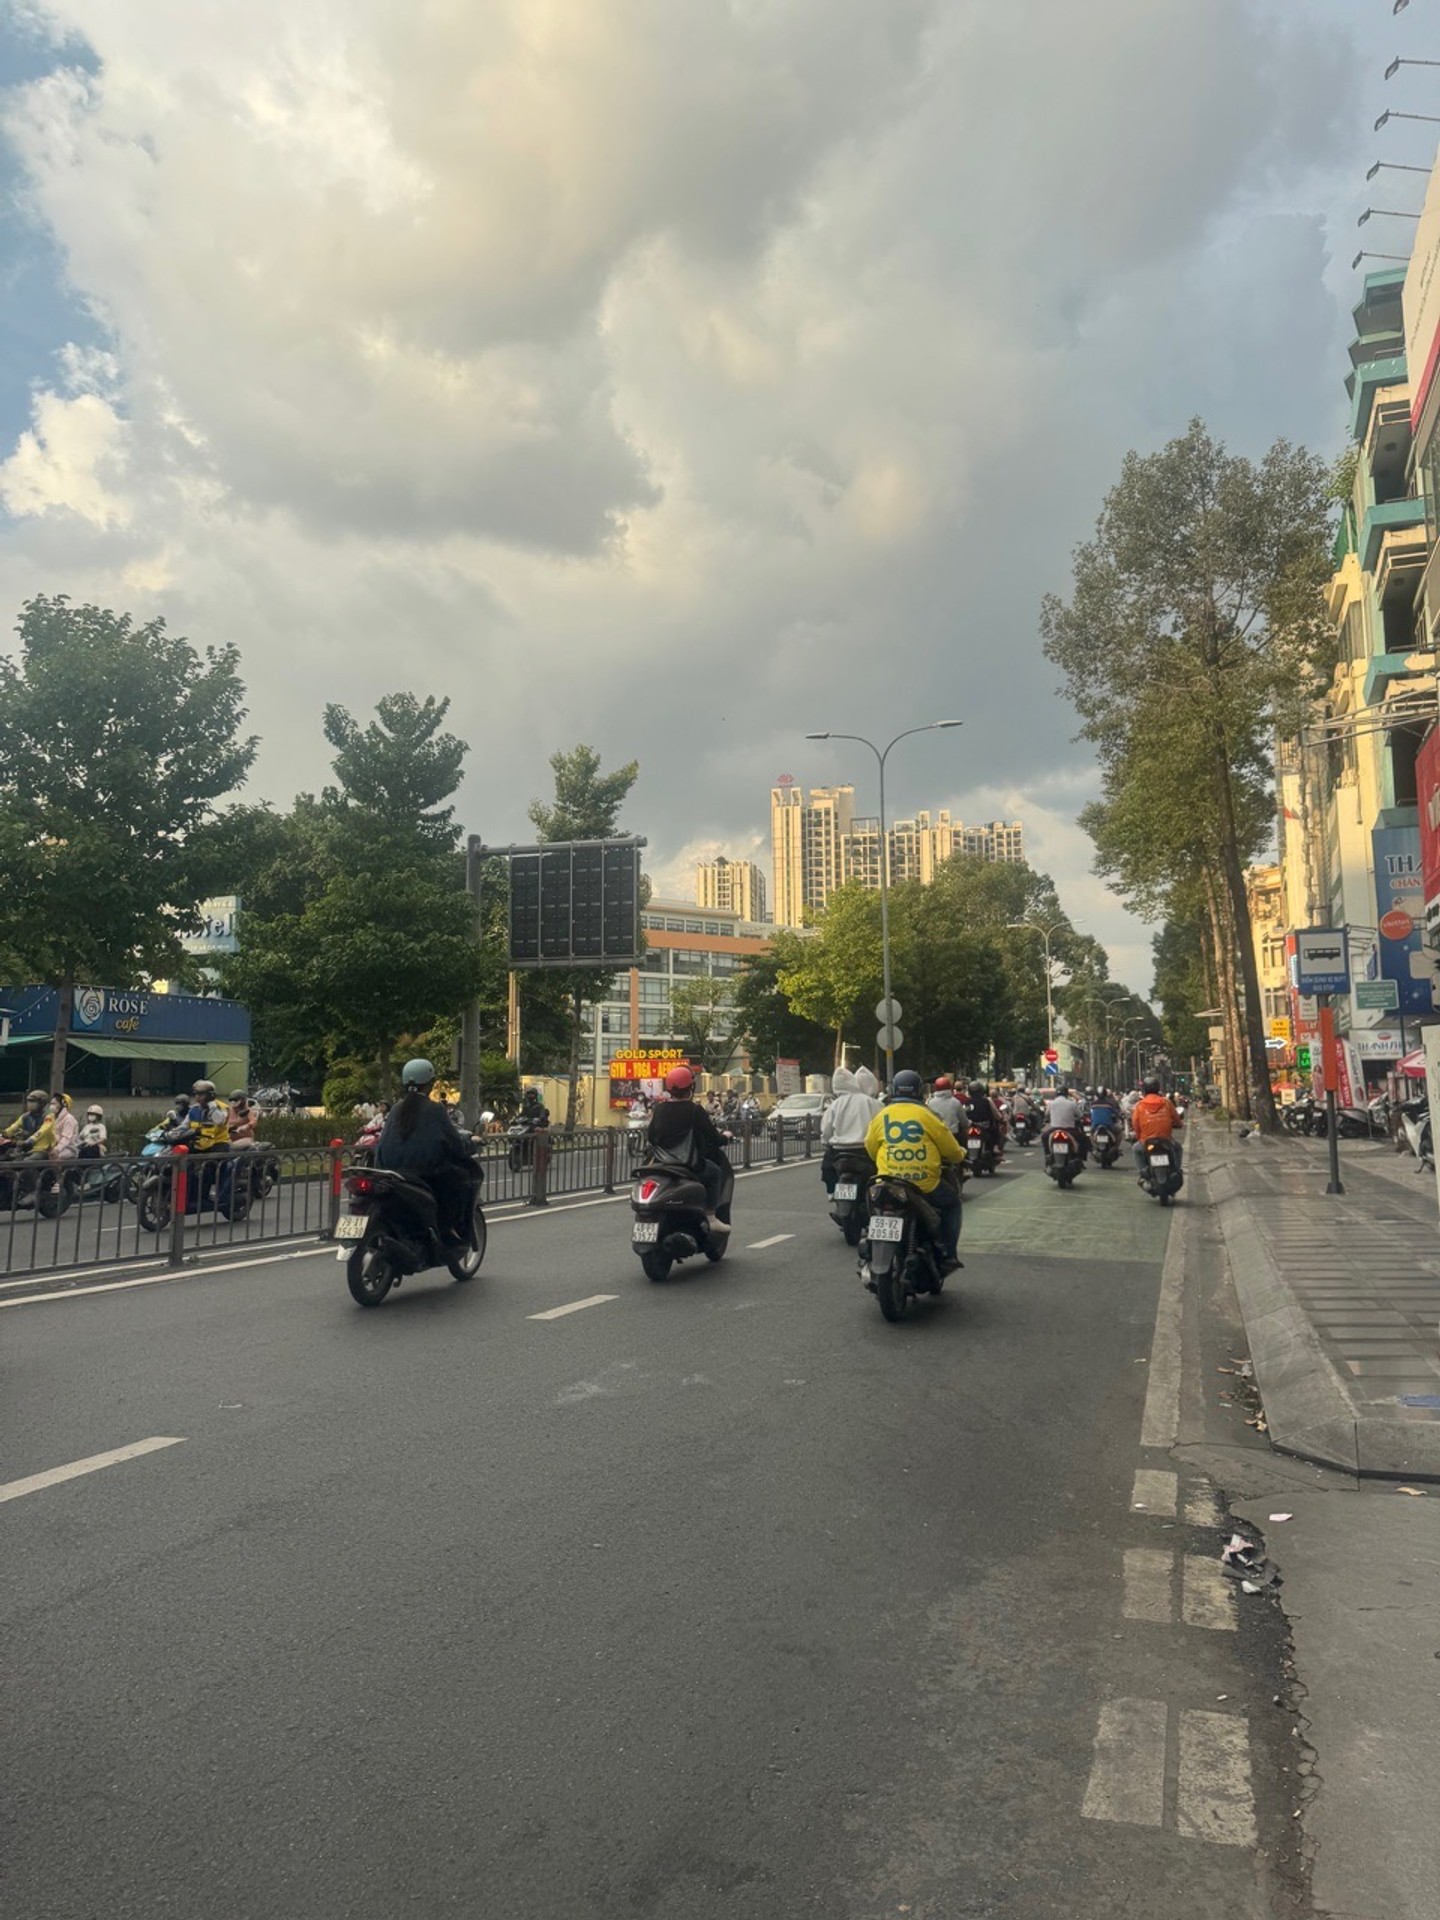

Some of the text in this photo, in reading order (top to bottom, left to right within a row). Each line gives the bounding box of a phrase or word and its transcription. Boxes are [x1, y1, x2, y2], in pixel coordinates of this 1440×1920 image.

[108, 997, 149, 1015] ROSE
[616, 1048, 684, 1059] GOLD SPORT
[610, 1062, 626, 1078] GYM
[633, 1062, 652, 1078] YOGA
[883, 1114, 924, 1144] be
[886, 1144, 927, 1162] Food
